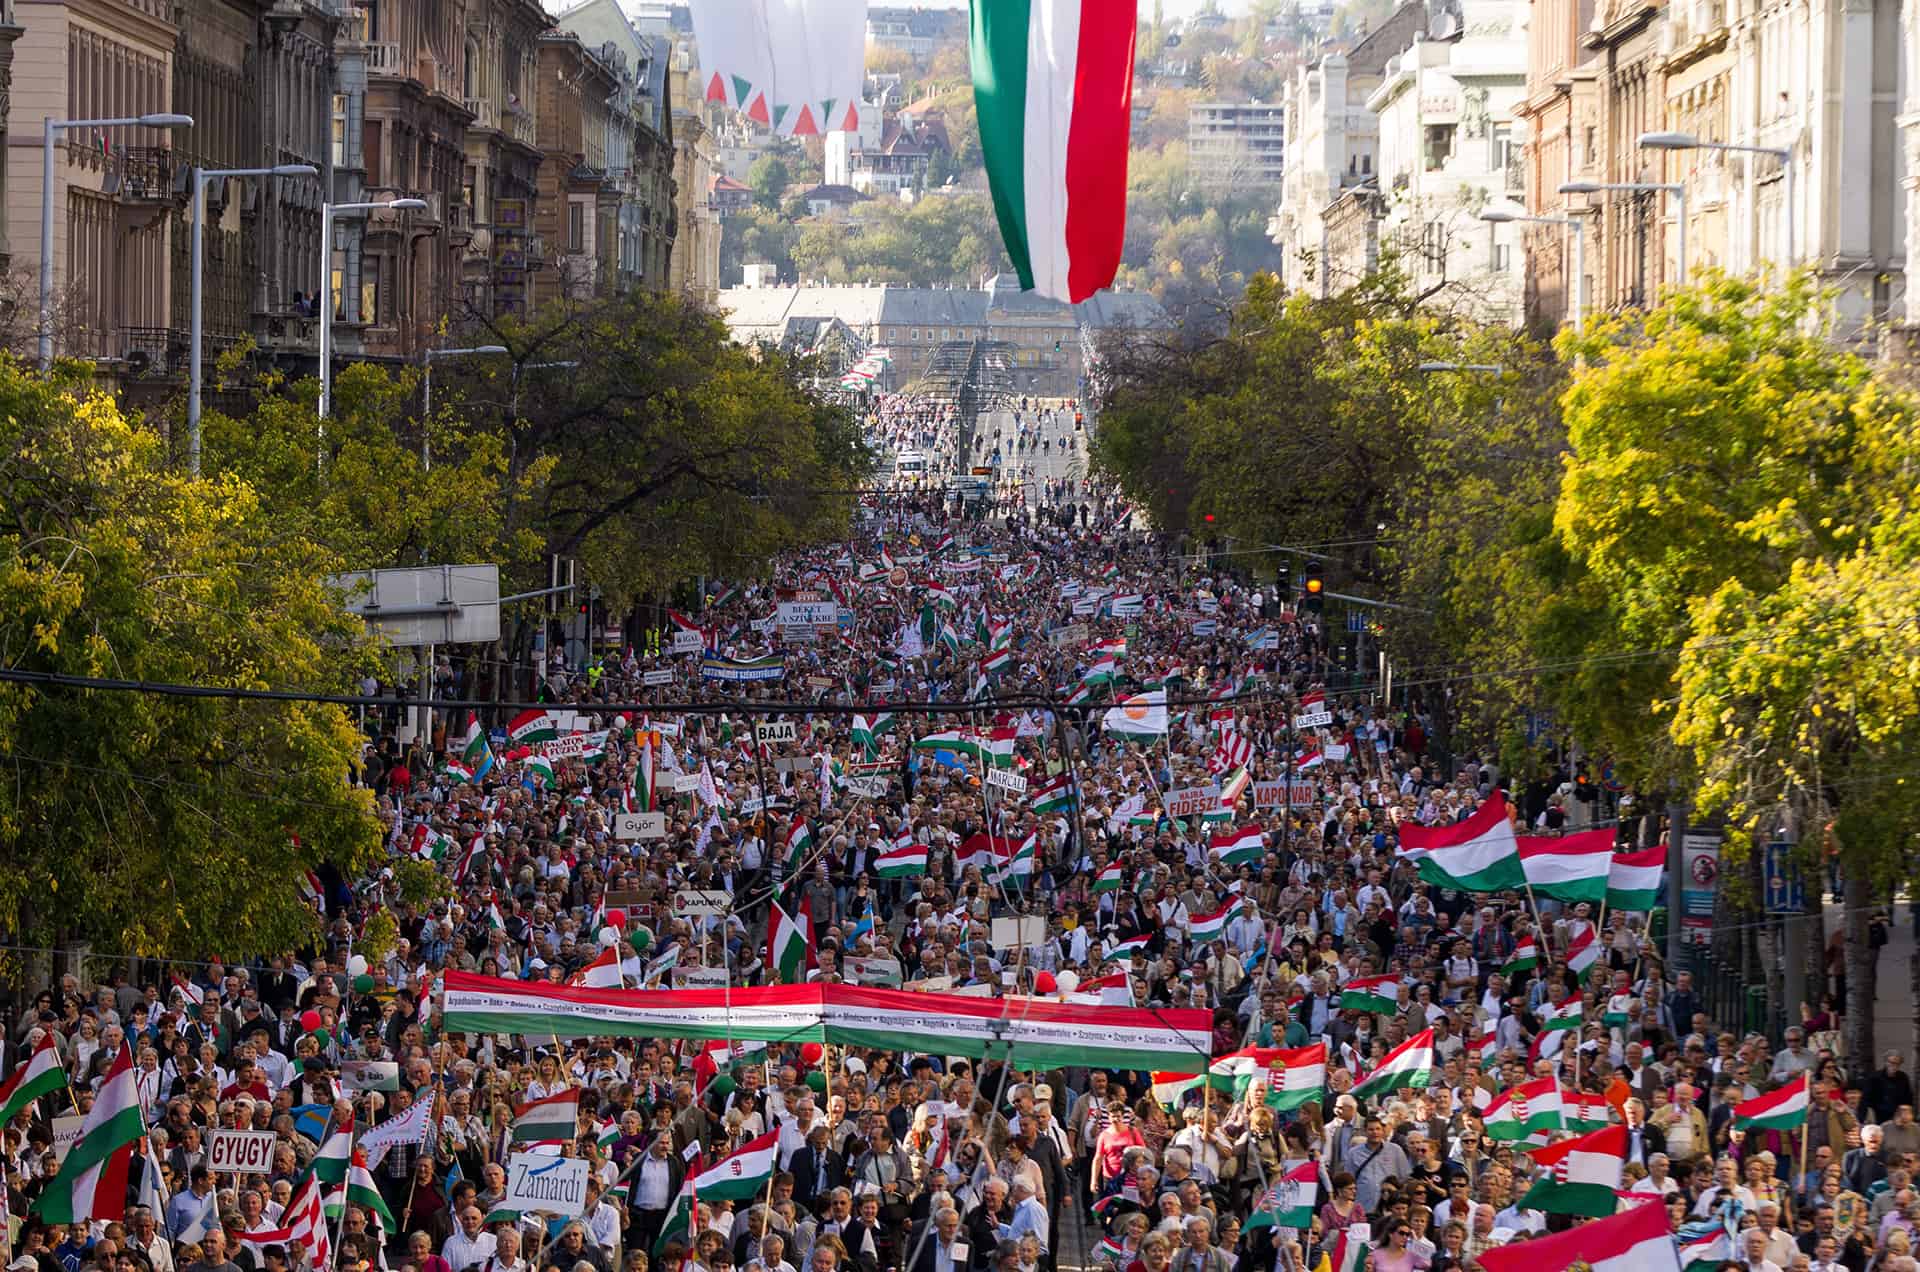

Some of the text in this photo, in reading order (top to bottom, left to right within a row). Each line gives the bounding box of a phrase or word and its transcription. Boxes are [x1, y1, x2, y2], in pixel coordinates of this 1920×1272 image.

[758, 725, 794, 740] BAJA
[988, 769, 1026, 790] MARCALI
[1256, 782, 1313, 805] KAPOVÁR
[1168, 796, 1218, 817] FIDESZ!
[212, 1136, 273, 1167] GYUGY
[514, 1163, 581, 1204] Zamárdi
